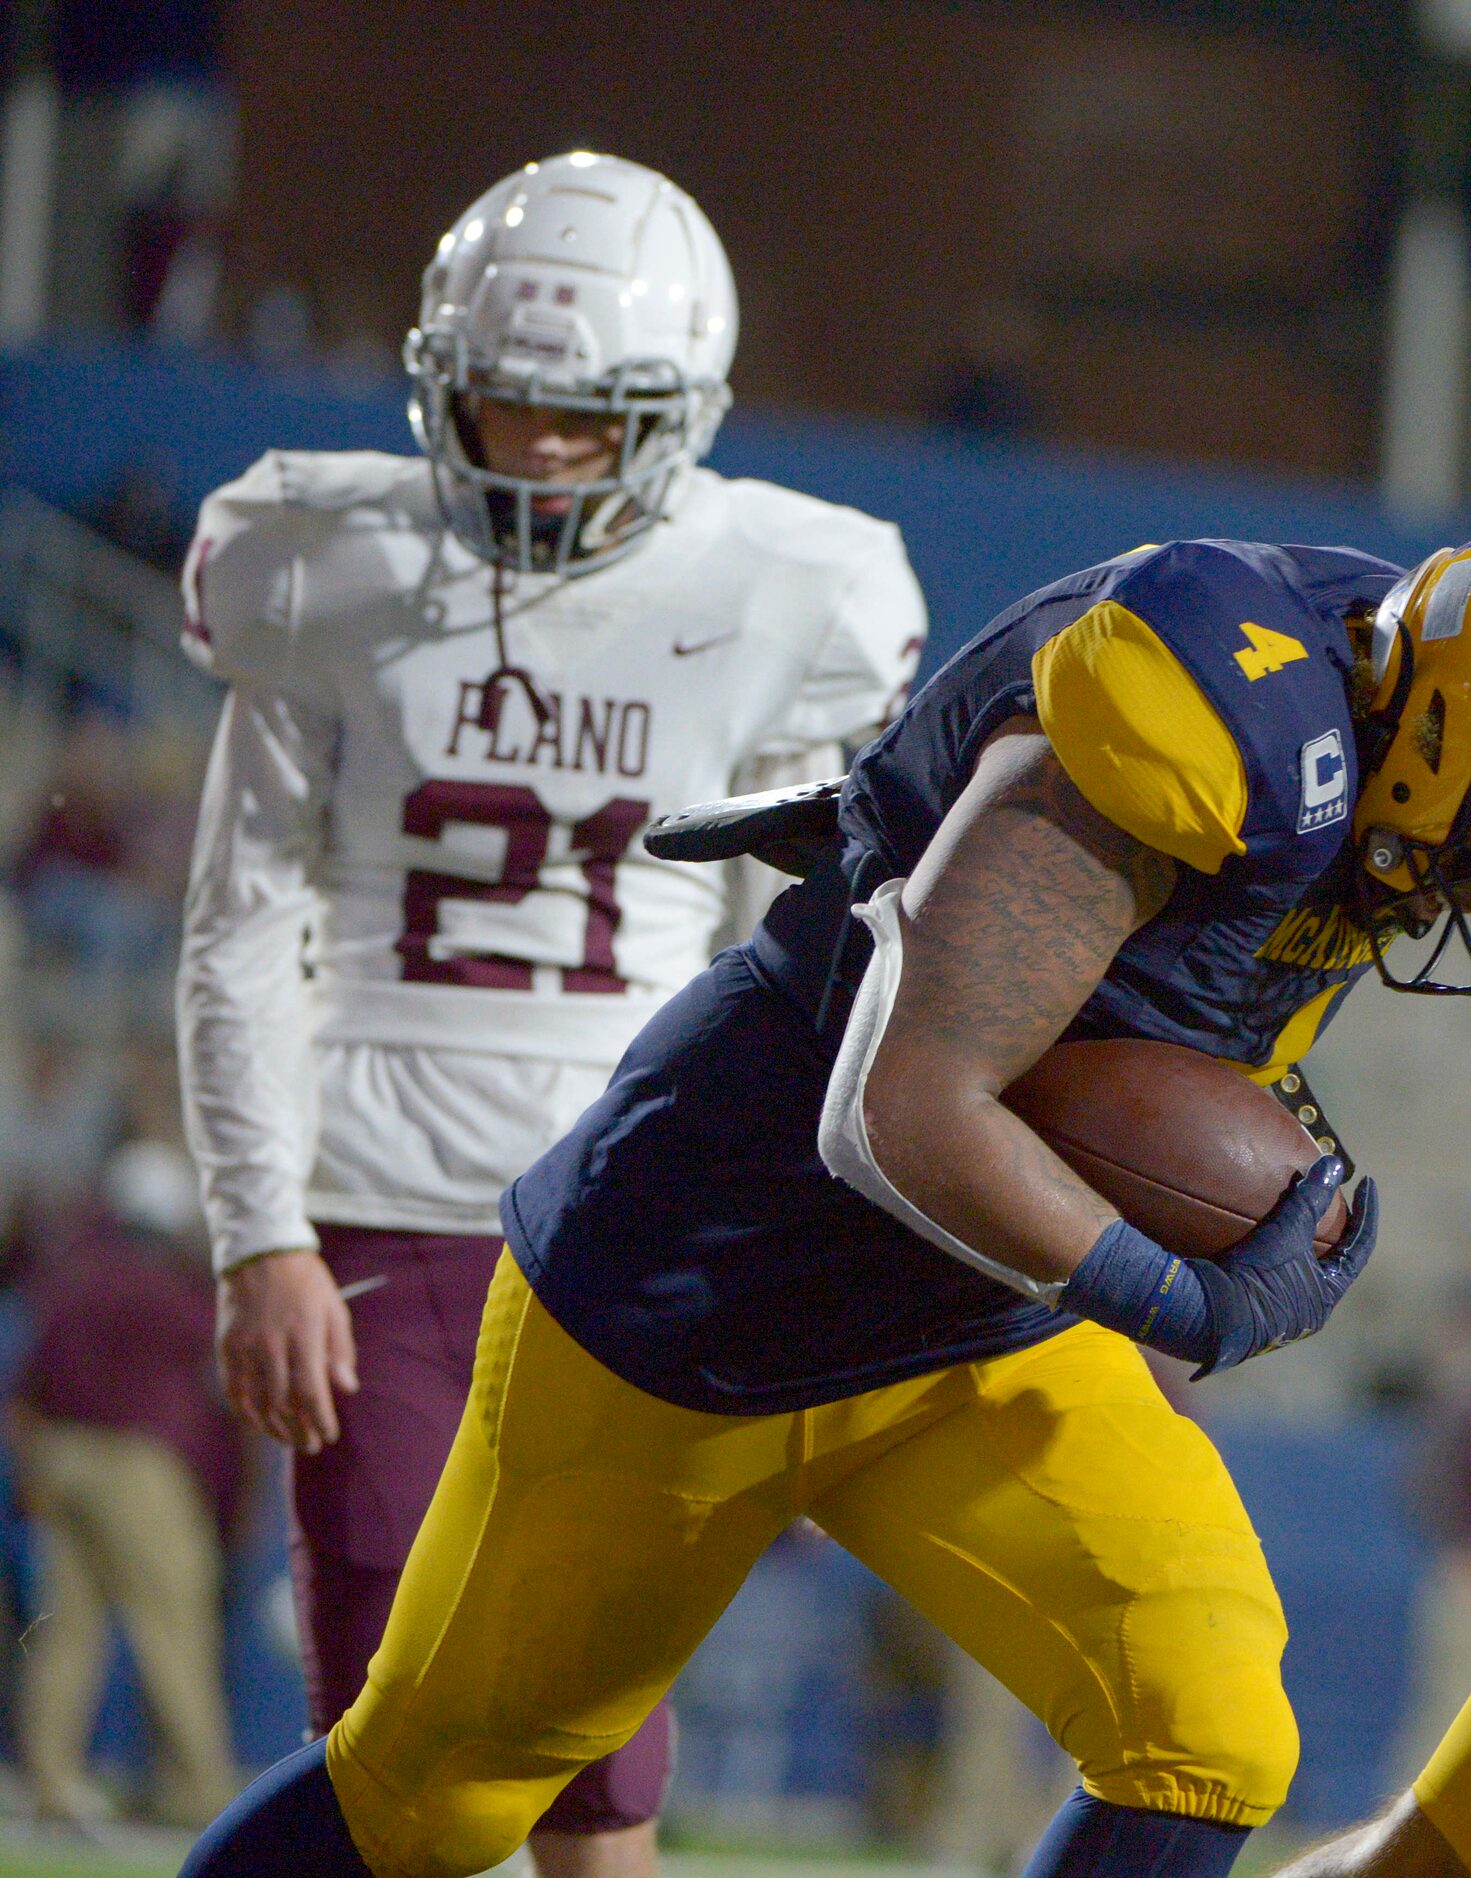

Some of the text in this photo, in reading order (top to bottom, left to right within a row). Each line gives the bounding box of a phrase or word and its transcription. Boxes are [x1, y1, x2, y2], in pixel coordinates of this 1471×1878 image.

[1233, 622, 1309, 682] 4
[446, 680, 653, 777] PLANO
[1304, 735, 1345, 808] C
[396, 778, 652, 994] 21
